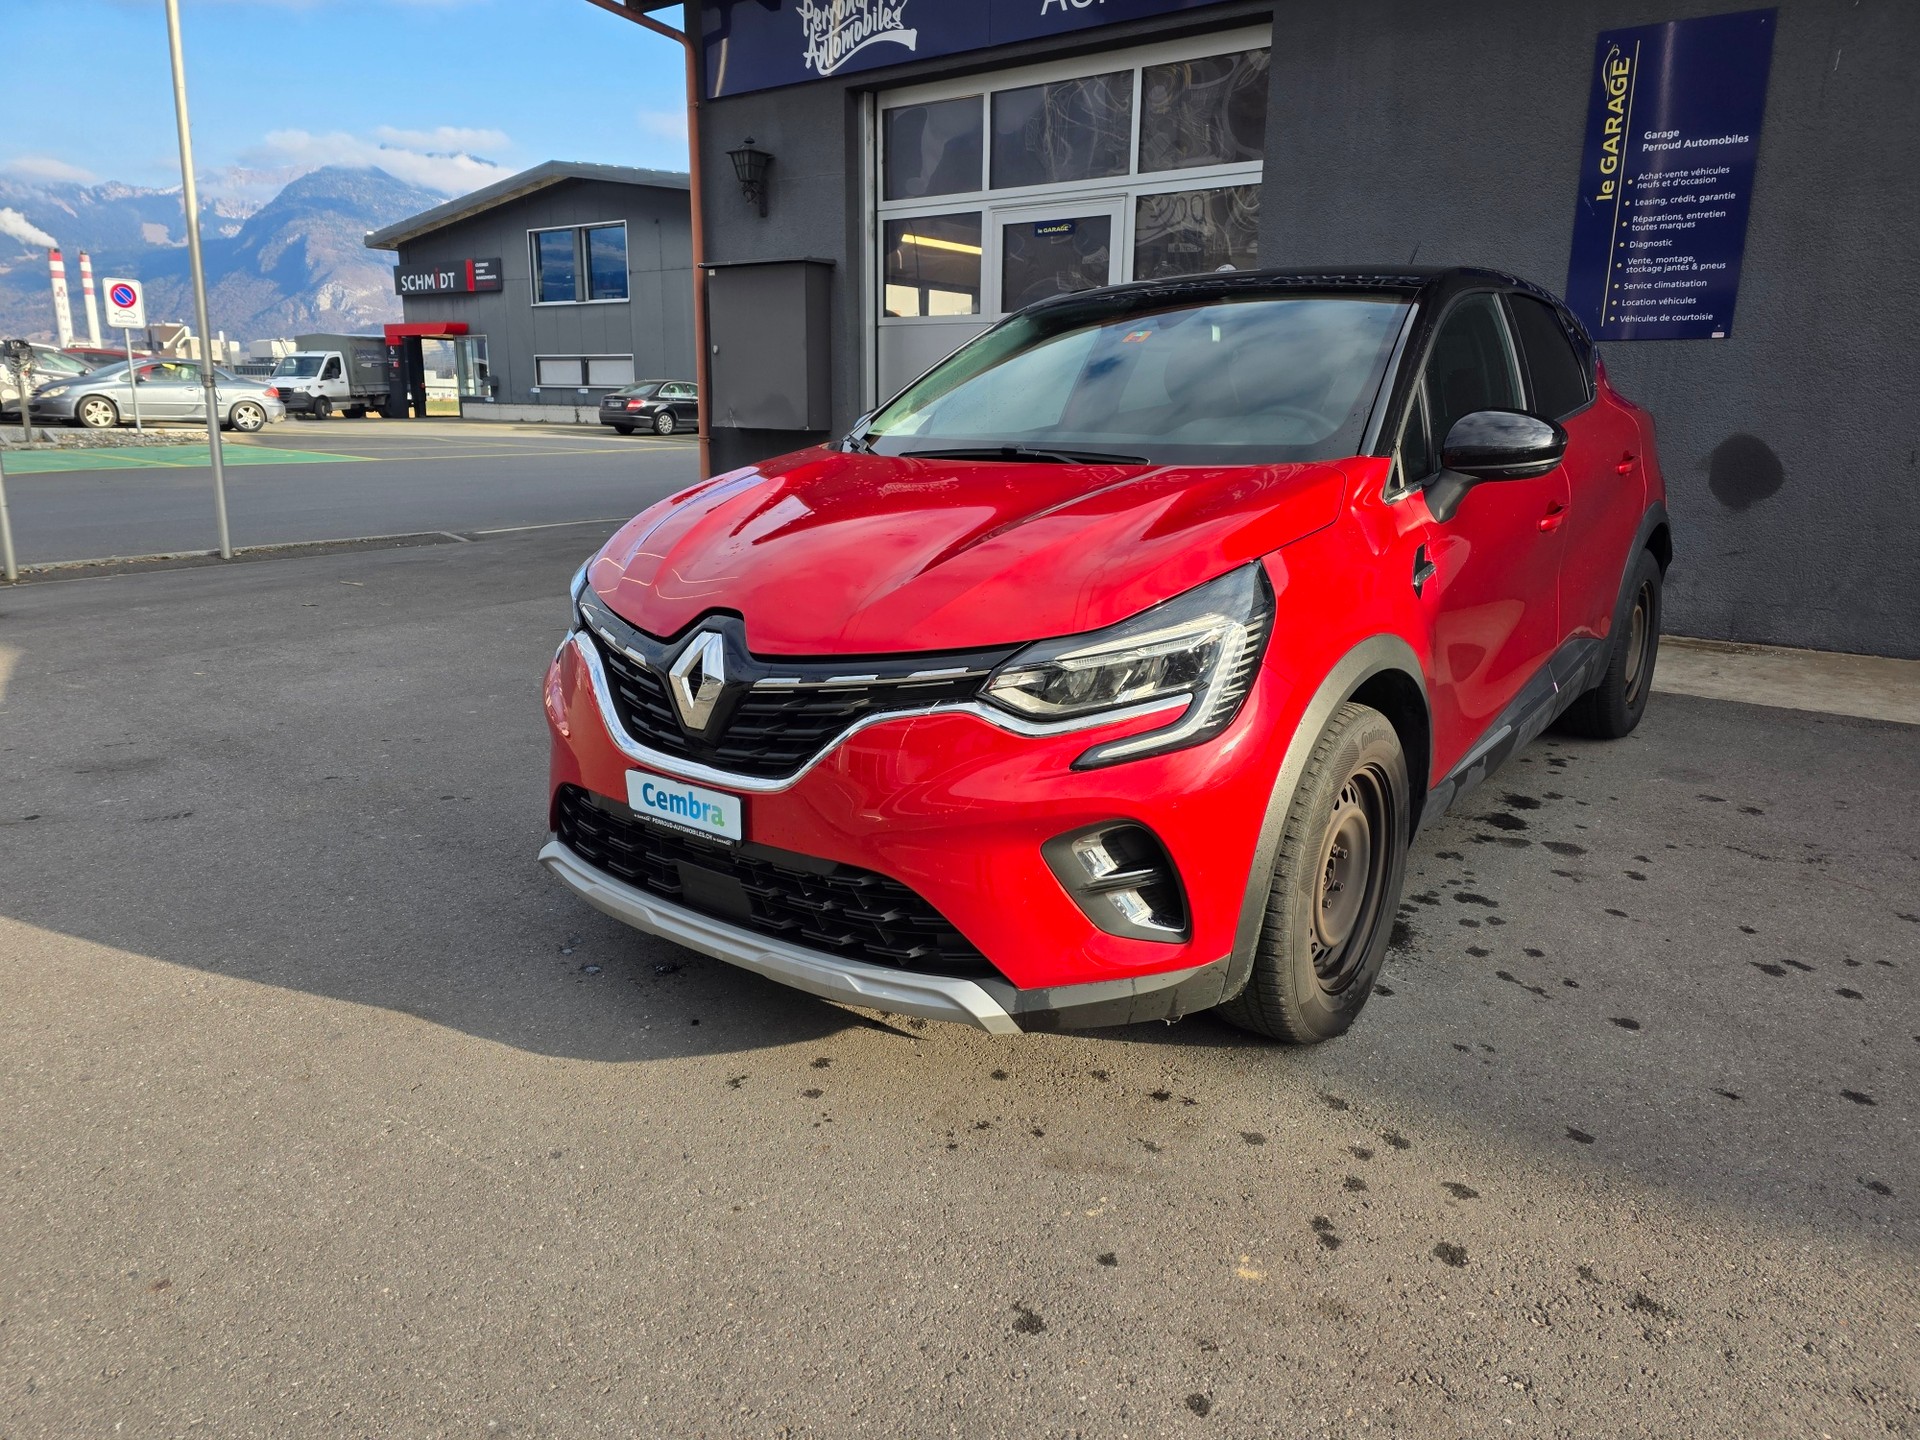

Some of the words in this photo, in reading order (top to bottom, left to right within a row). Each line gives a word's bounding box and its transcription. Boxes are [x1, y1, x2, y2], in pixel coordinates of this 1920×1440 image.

[1600, 57, 1630, 175] GARAGE
[1644, 130, 1679, 140] Garage
[1642, 140, 1681, 152] Perroud
[1684, 134, 1749, 148] Automobiles
[1638, 170, 1688, 181] Achat-vente
[1691, 166, 1730, 176] véhicules
[1637, 180, 1660, 189] neufs
[1662, 179, 1670, 187] et
[1596, 180, 1615, 201] le
[1635, 197, 1668, 206] Leasing,
[1670, 195, 1697, 203] crédit,
[1699, 192, 1736, 203] garantie
[1633, 214, 1684, 224] Réparations,
[1686, 210, 1726, 219] entretien
[1043, 225, 1069, 233] GARAGE
[1632, 222, 1658, 231] toutes
[1660, 221, 1696, 230] marques
[1629, 239, 1673, 249] Diagnostic
[1627, 257, 1653, 265] Vente,
[1655, 255, 1696, 264] montage,
[1626, 265, 1662, 274] stockage
[1663, 263, 1689, 274] jantes
[1700, 262, 1726, 271] pneus
[1624, 282, 1652, 290] Service
[1654, 279, 1707, 289] climatisation
[1622, 297, 1656, 306] Location
[1659, 295, 1696, 304] véhicules
[1620, 314, 1658, 323] Véhicules
[1660, 313, 1670, 321] de
[1672, 312, 1713, 321] courtoisie
[642, 782, 725, 827] Cembra
